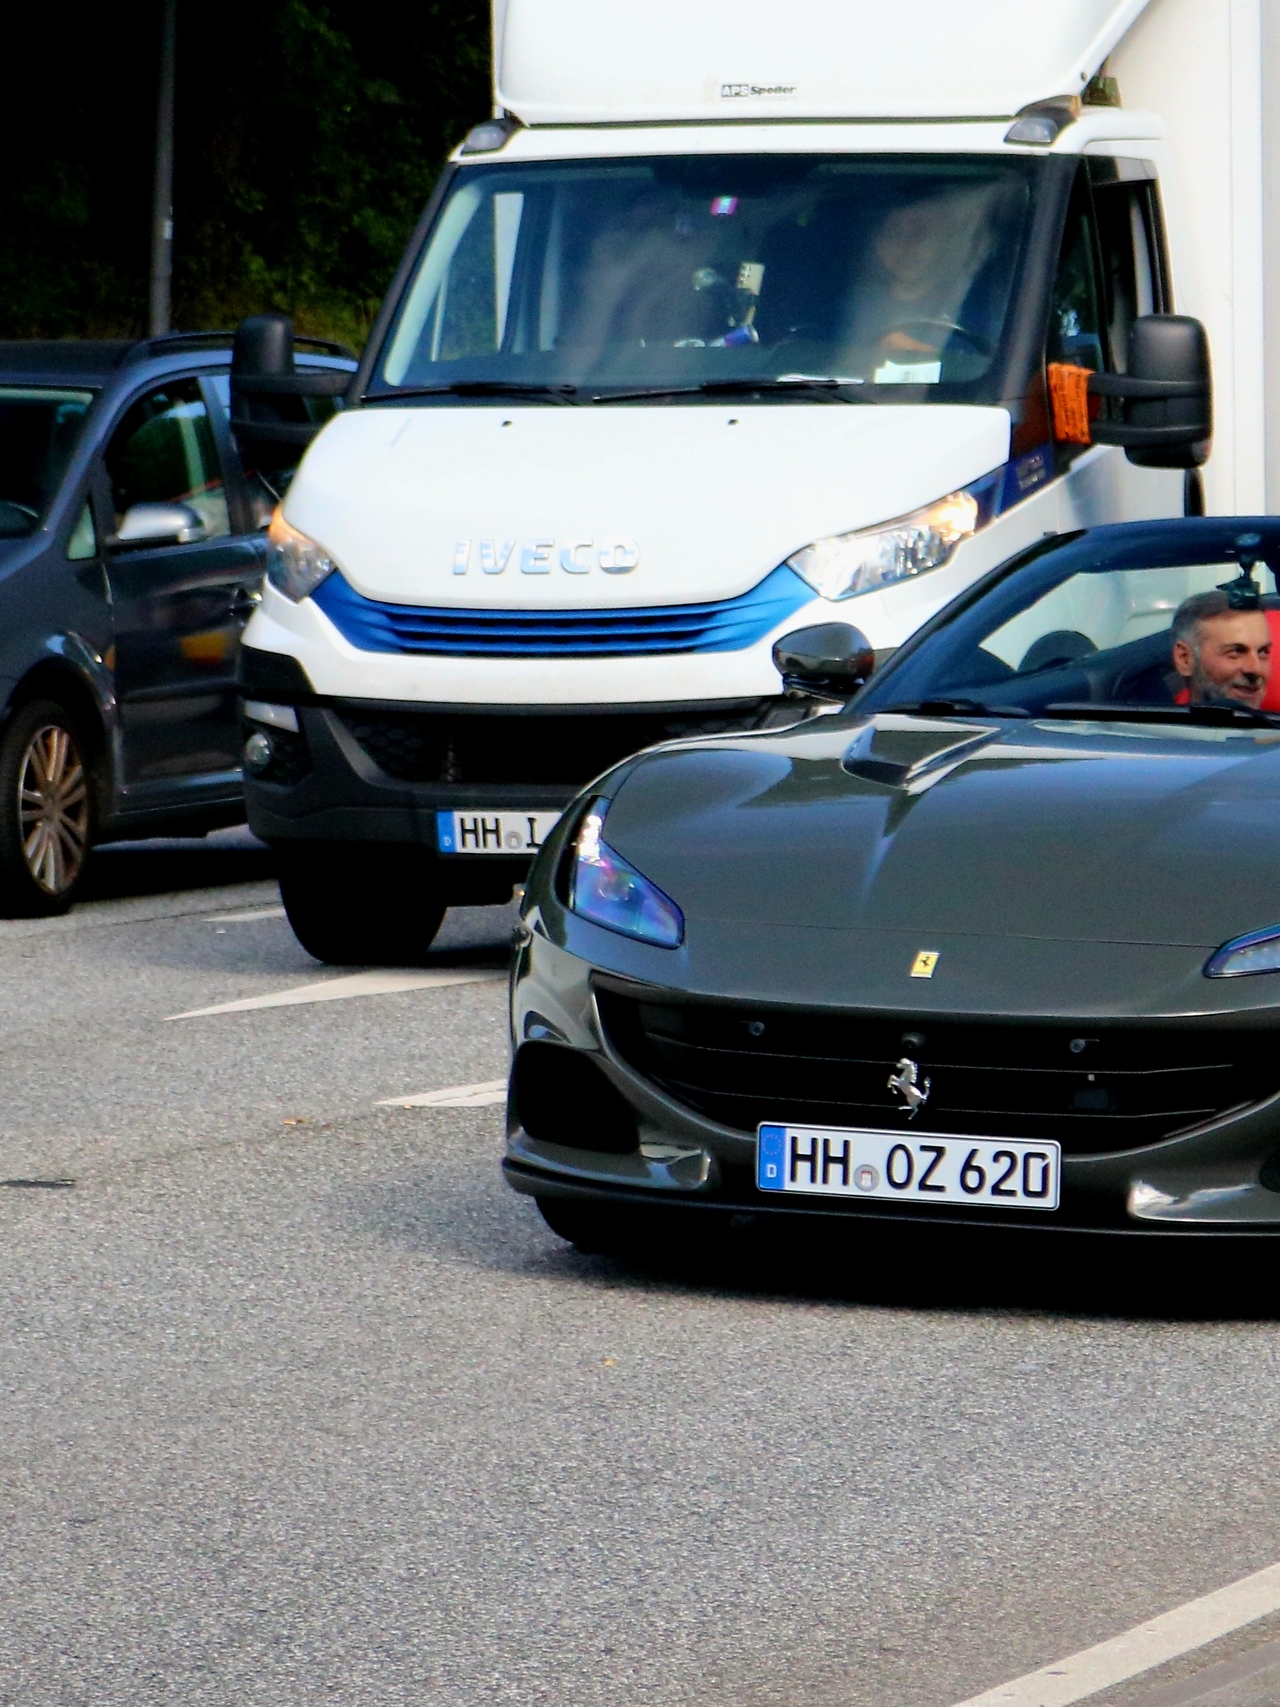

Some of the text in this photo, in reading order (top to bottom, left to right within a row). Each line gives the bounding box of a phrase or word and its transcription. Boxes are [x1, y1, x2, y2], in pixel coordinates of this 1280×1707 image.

[721, 84, 749, 98] APS
[453, 539, 641, 575] IVECO
[460, 817, 503, 848] HH
[767, 1136, 1050, 1199] D HH OZ 620
